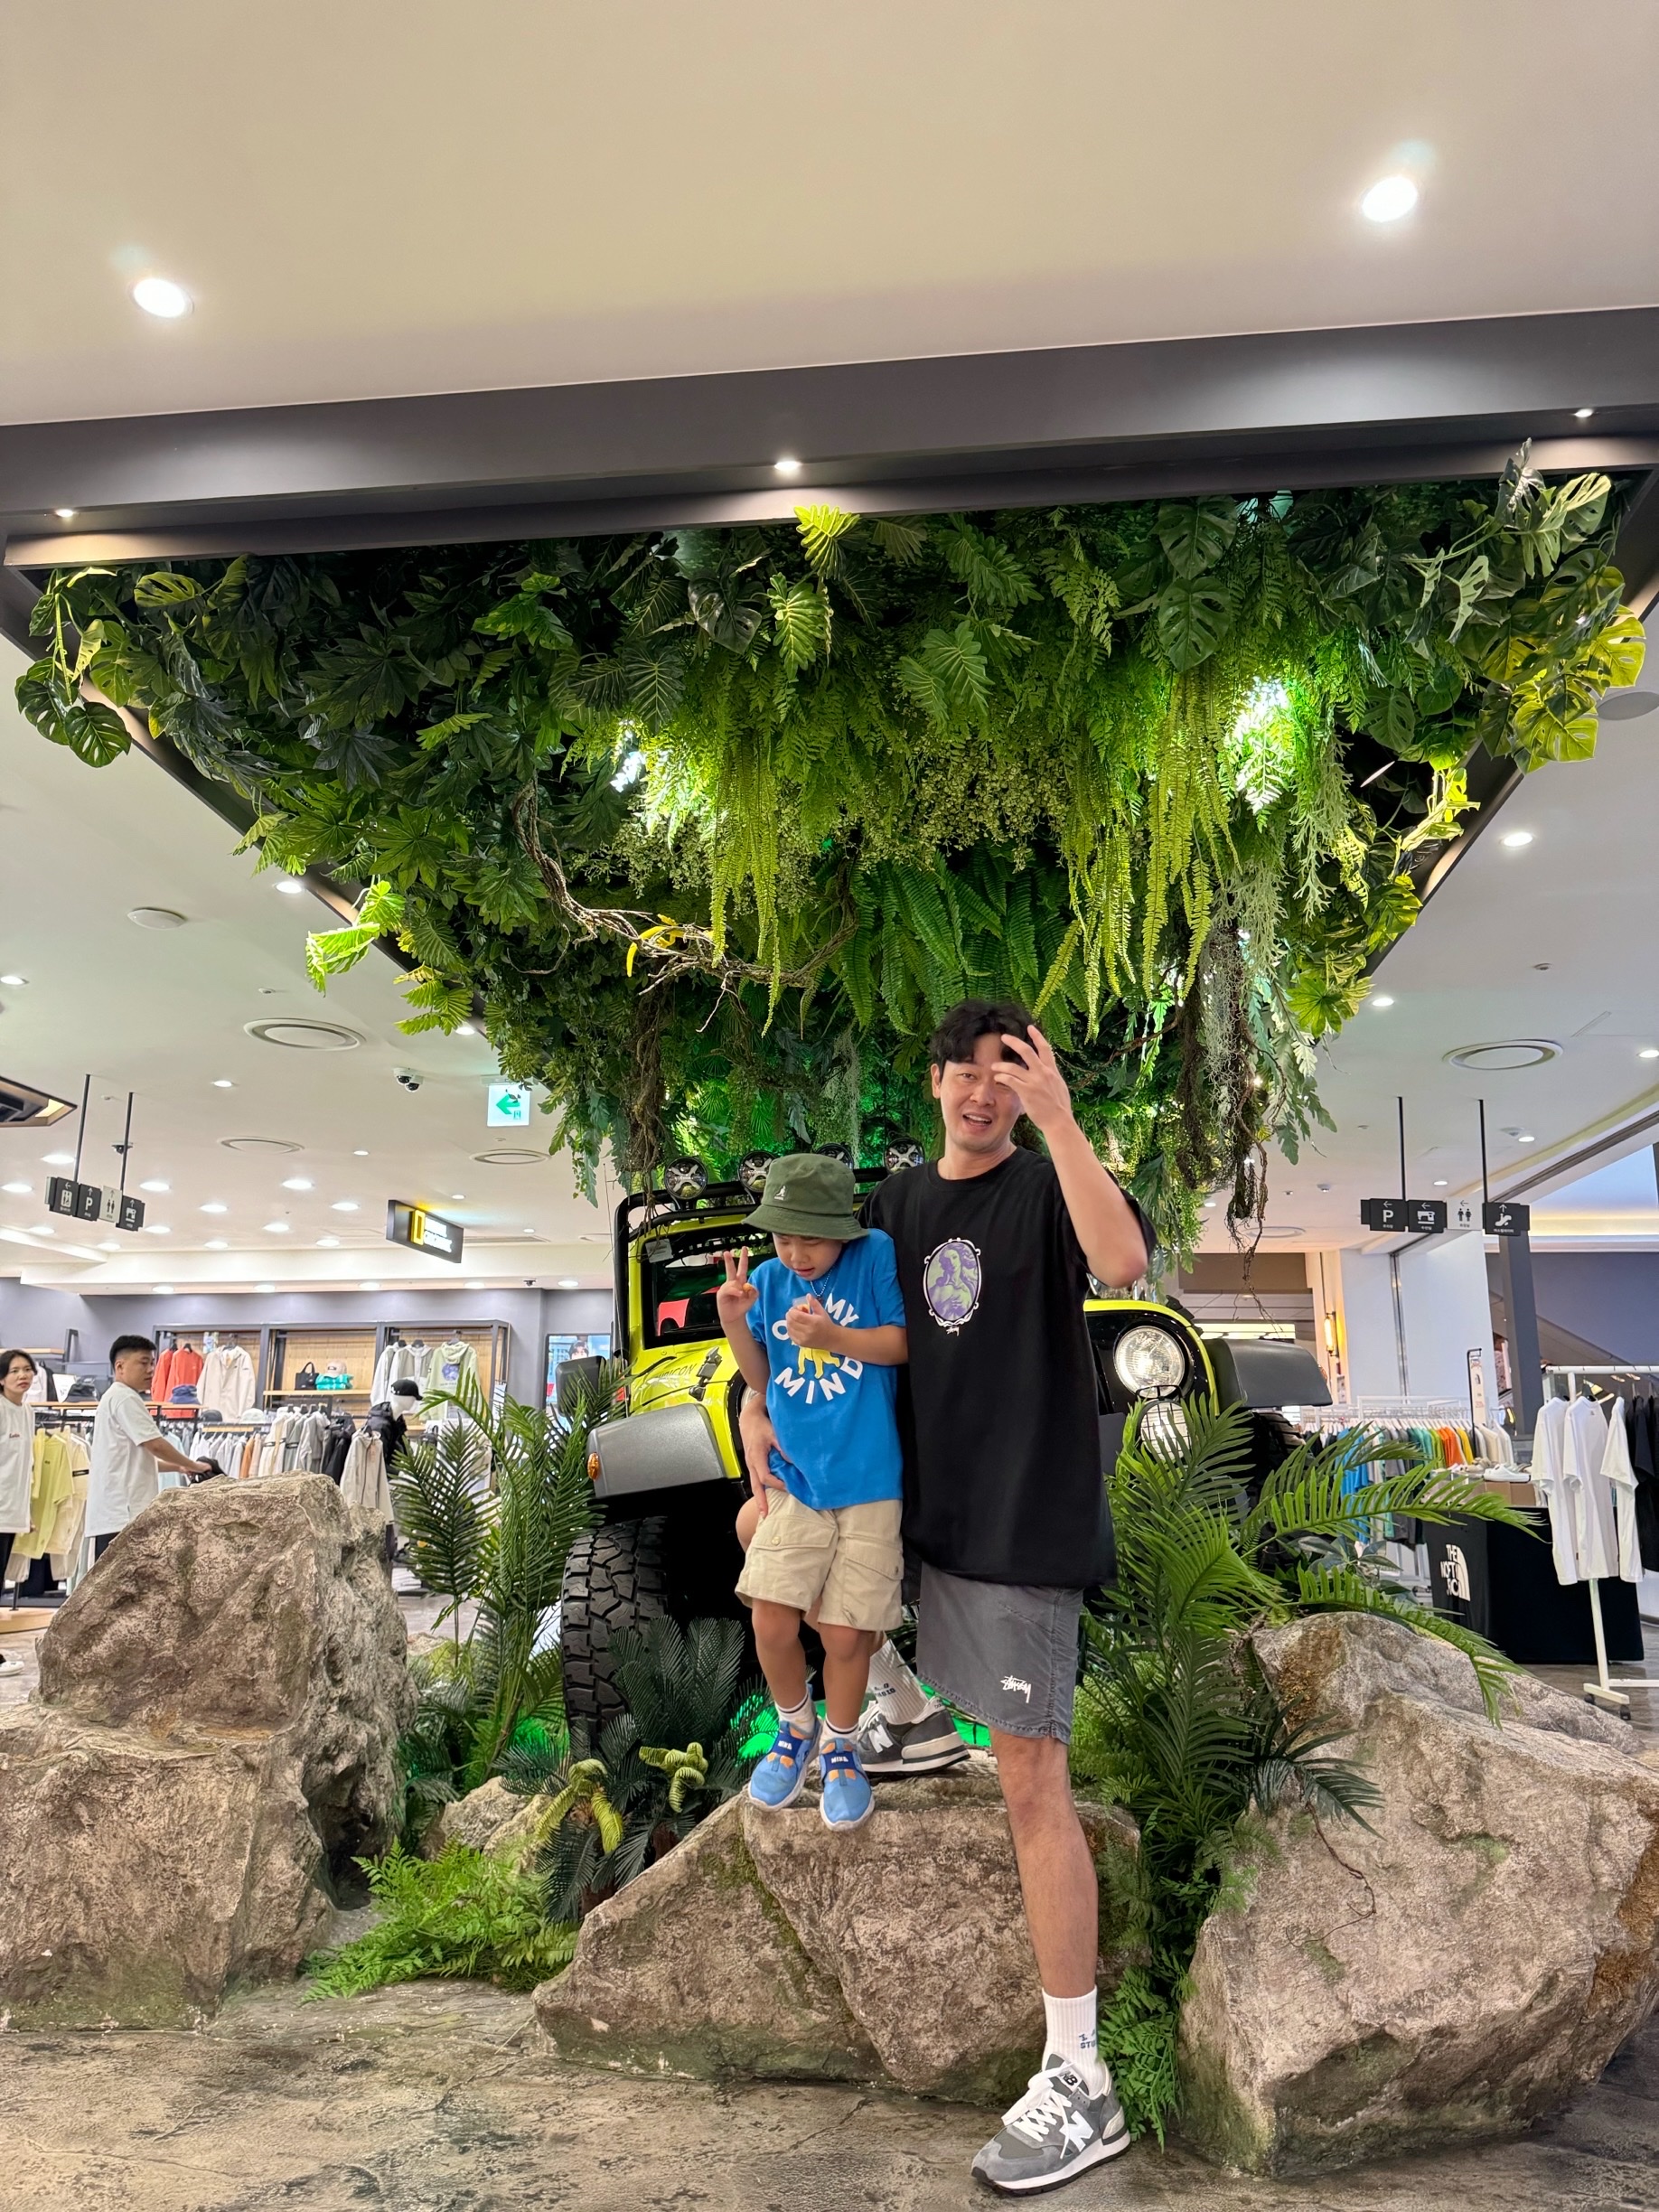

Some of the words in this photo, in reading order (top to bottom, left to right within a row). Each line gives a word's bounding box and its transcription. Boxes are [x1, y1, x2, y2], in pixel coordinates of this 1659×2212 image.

[85, 1196, 94, 1211] P
[1382, 1209, 1394, 1223] P
[824, 1292, 859, 1326] MY
[774, 1357, 864, 1404] MIND
[1446, 1543, 1457, 1562] THE
[1080, 2041, 1096, 2049] STU
